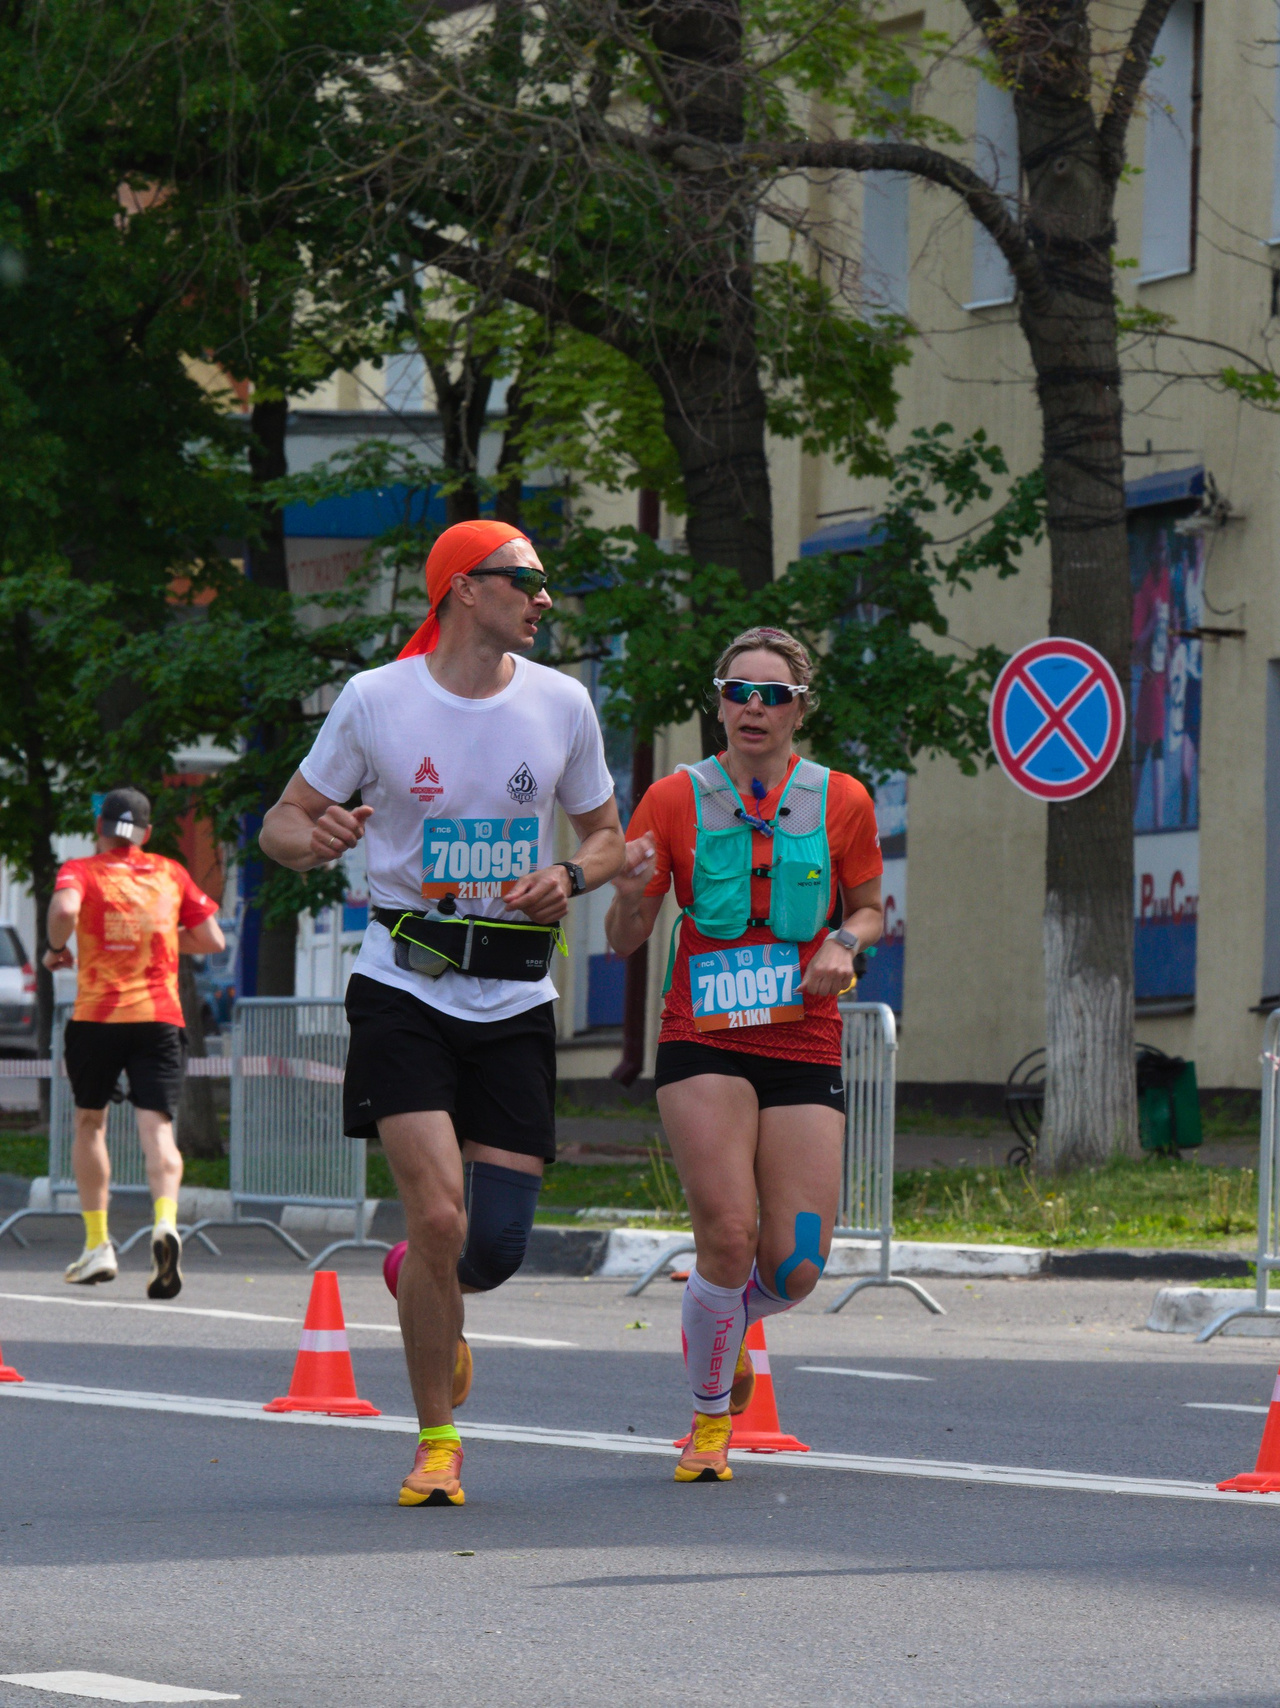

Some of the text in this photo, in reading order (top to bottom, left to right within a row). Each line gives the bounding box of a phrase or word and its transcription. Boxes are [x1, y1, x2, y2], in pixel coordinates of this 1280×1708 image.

[473, 821, 493, 839] 10
[430, 840, 532, 880] 70093
[734, 949, 754, 967] 10
[697, 964, 794, 1013] 70097
